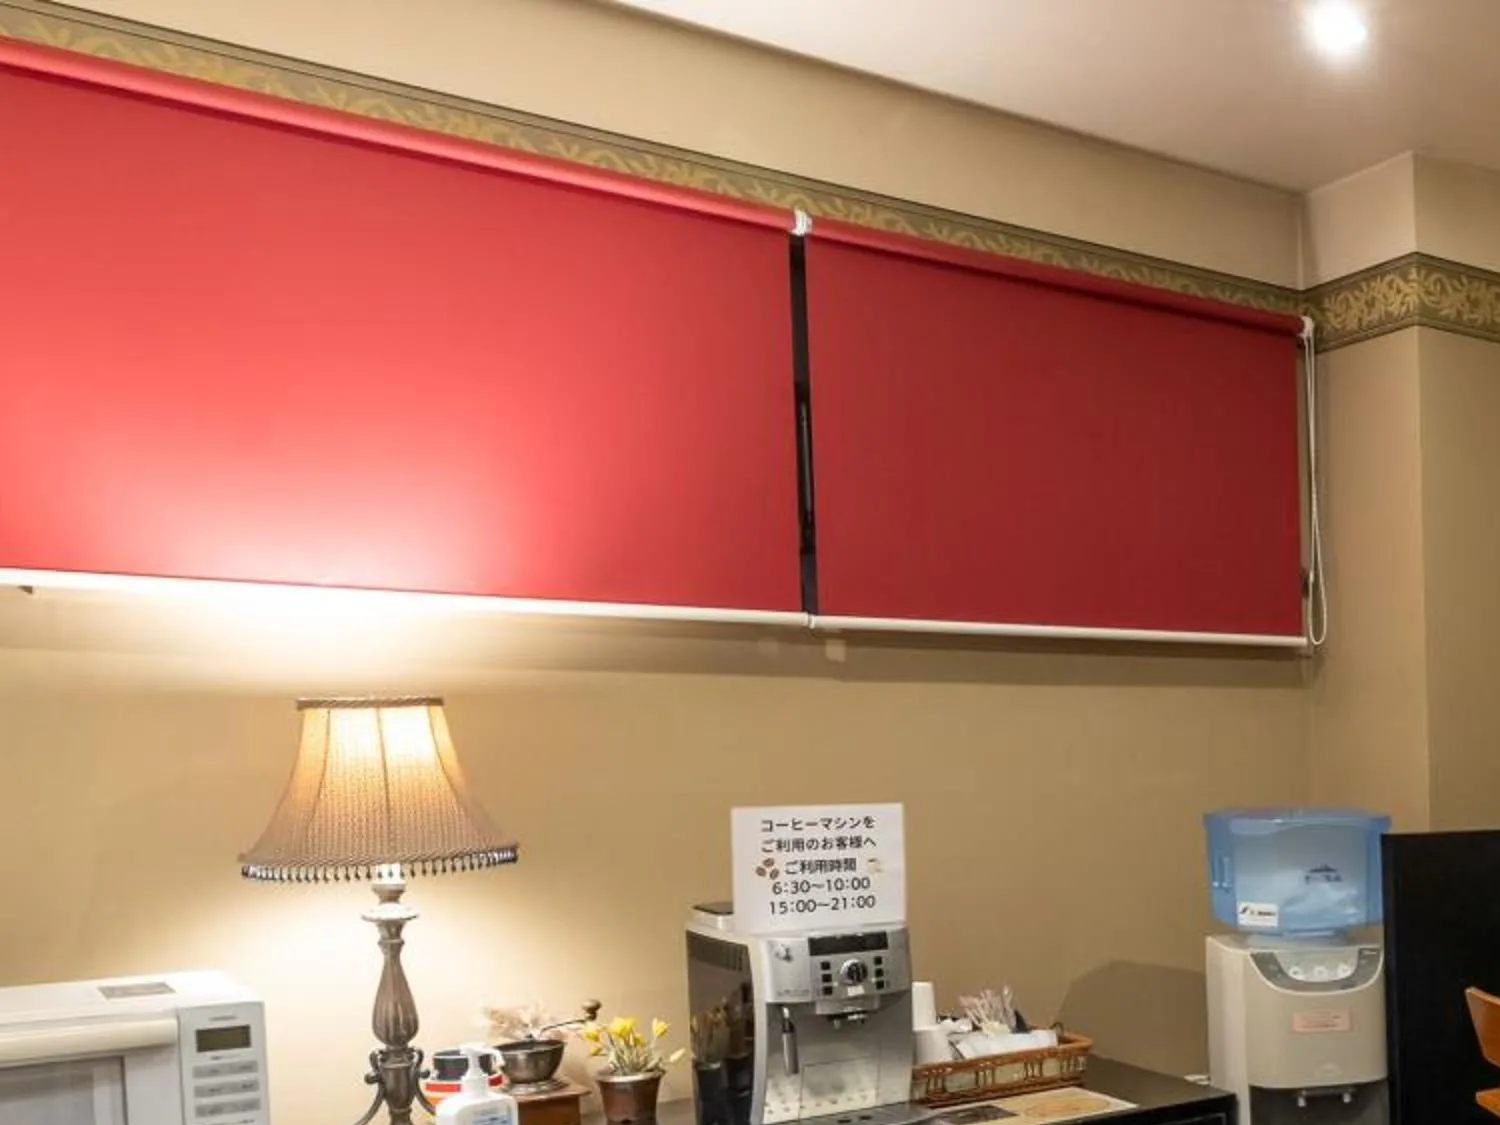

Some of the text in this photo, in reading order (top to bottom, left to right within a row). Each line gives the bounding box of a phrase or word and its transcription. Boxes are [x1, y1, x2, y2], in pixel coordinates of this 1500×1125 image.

[761, 816, 875, 832] コーヒーマシンを
[761, 835, 877, 853] ご利用のお客様へ
[784, 857, 857, 875] ご利用時間
